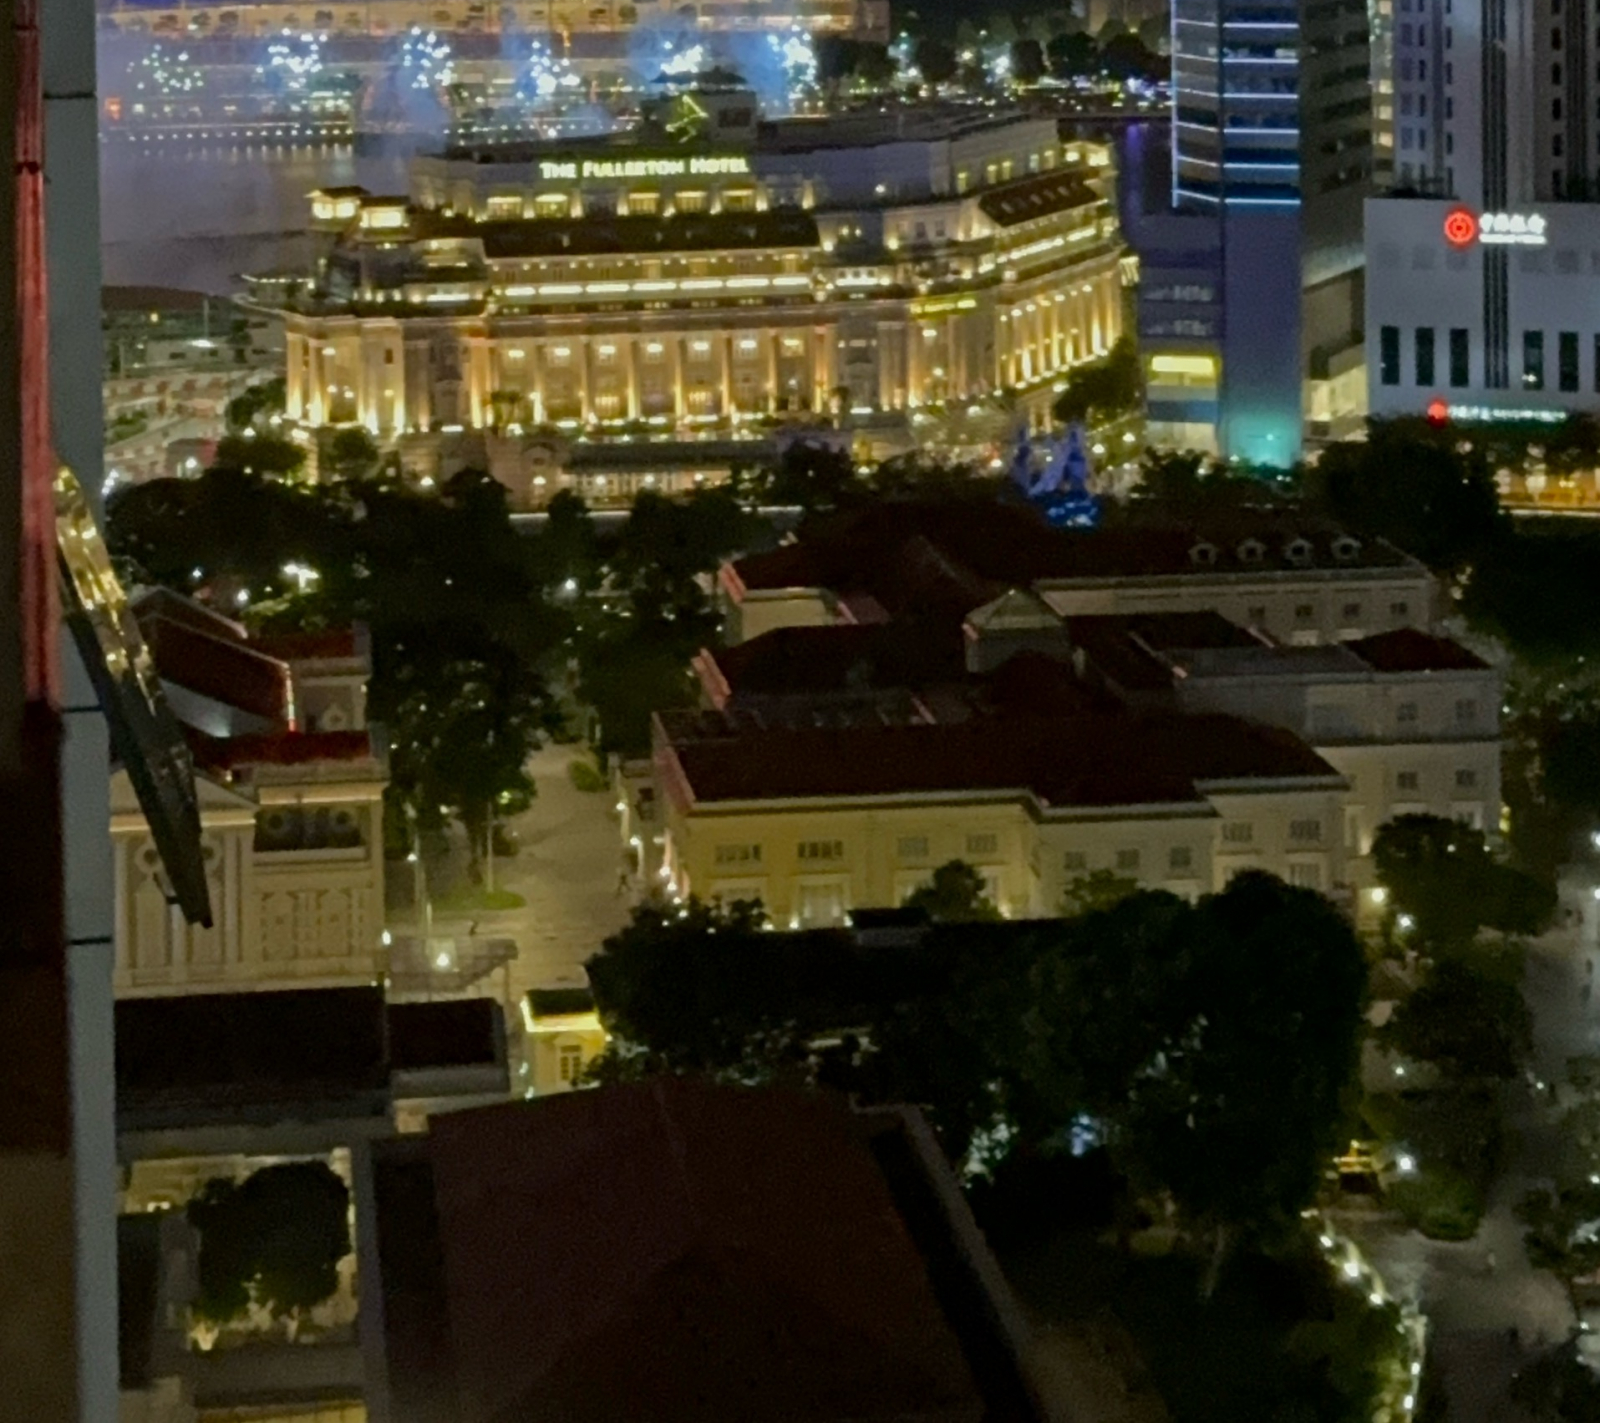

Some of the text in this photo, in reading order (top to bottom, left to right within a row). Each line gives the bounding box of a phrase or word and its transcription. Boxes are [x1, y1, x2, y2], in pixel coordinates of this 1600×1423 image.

[540, 157, 749, 178] THE FULLERTON HOTEL
